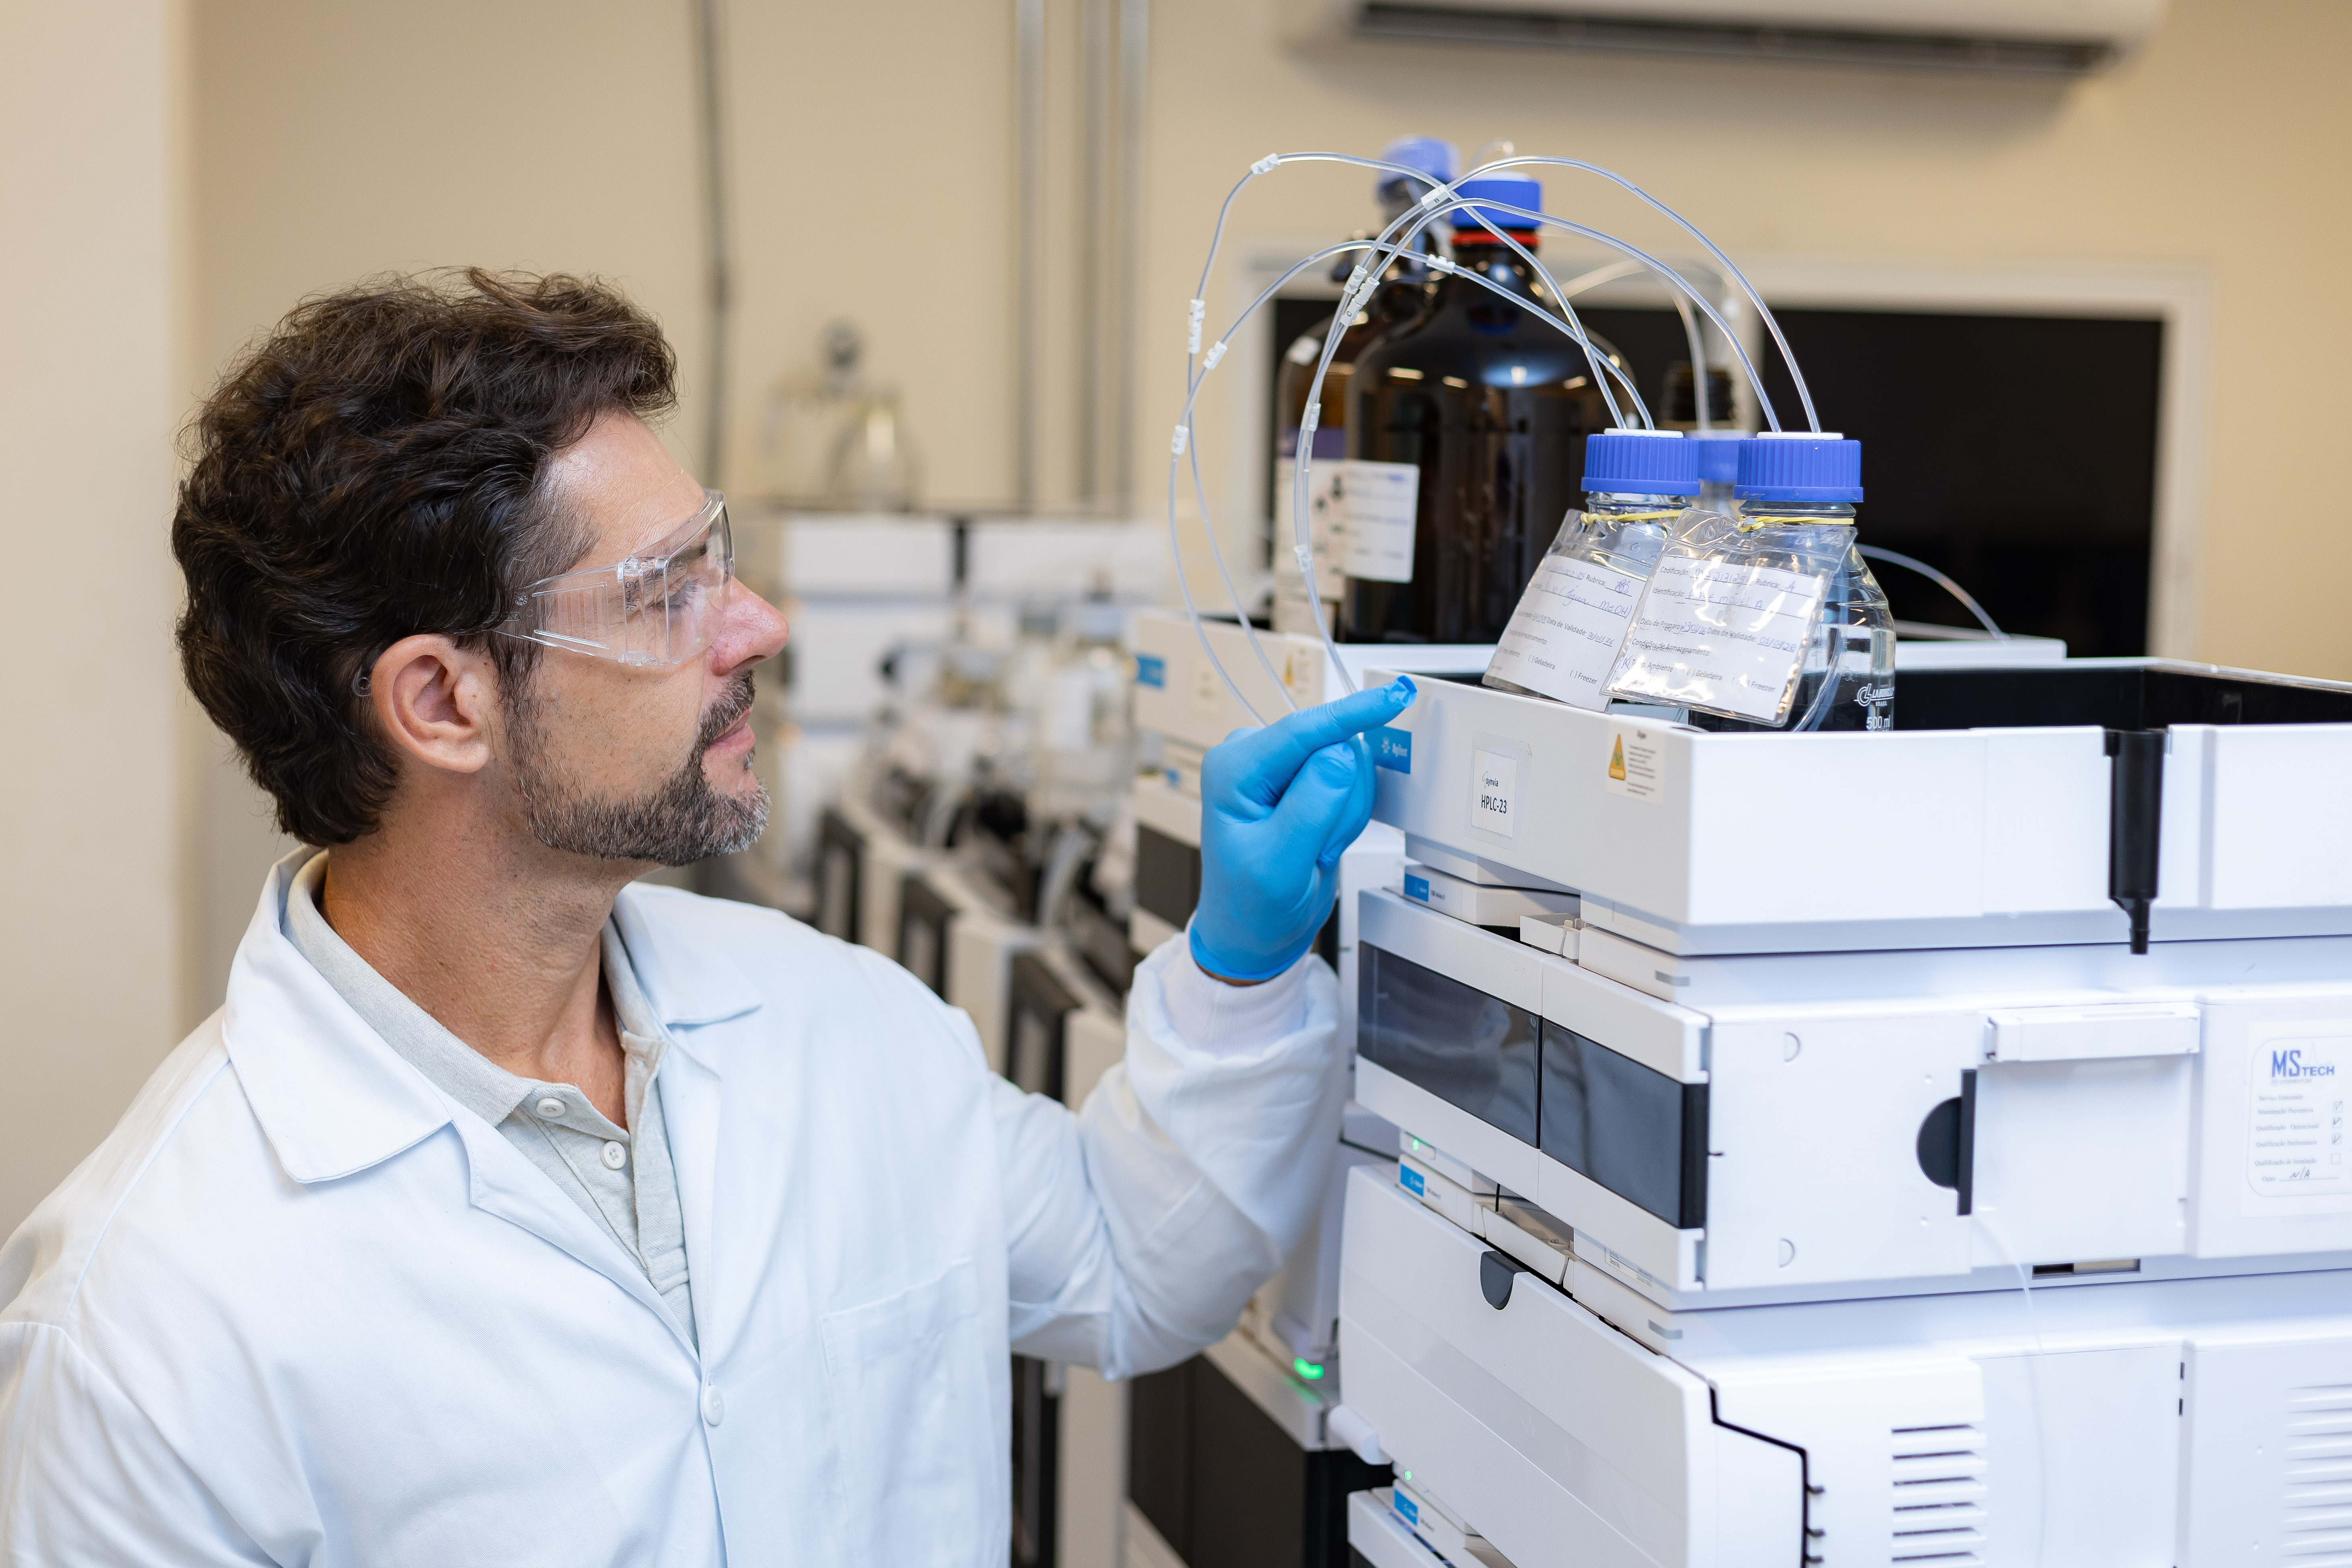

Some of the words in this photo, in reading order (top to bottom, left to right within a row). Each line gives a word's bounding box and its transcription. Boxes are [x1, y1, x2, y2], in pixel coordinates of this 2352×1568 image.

[1586, 574, 1606, 586] Rubrica:
[1660, 567, 1690, 576] Codificação:
[1755, 579, 1780, 588] Rubrica:
[1652, 587, 1686, 598] Identificação:
[1546, 617, 1556, 626] Data
[1565, 623, 1587, 636] Validade:
[1730, 631, 1757, 642] Validade:
[1632, 639, 1657, 648] Condições
[1666, 644, 1711, 657] Armazenamento:
[1534, 657, 1556, 670] Geladeira
[1577, 672, 1597, 685] Freezer
[1647, 662, 1673, 672] Ambiente
[1696, 670, 1723, 681] Geladeira
[1751, 681, 1776, 692] Freezer
[1866, 716, 1882, 730] 500
[1884, 715, 1891, 728] ml
[1486, 778, 1499, 787] synvia
[1481, 794, 1507, 814] HPLC-23
